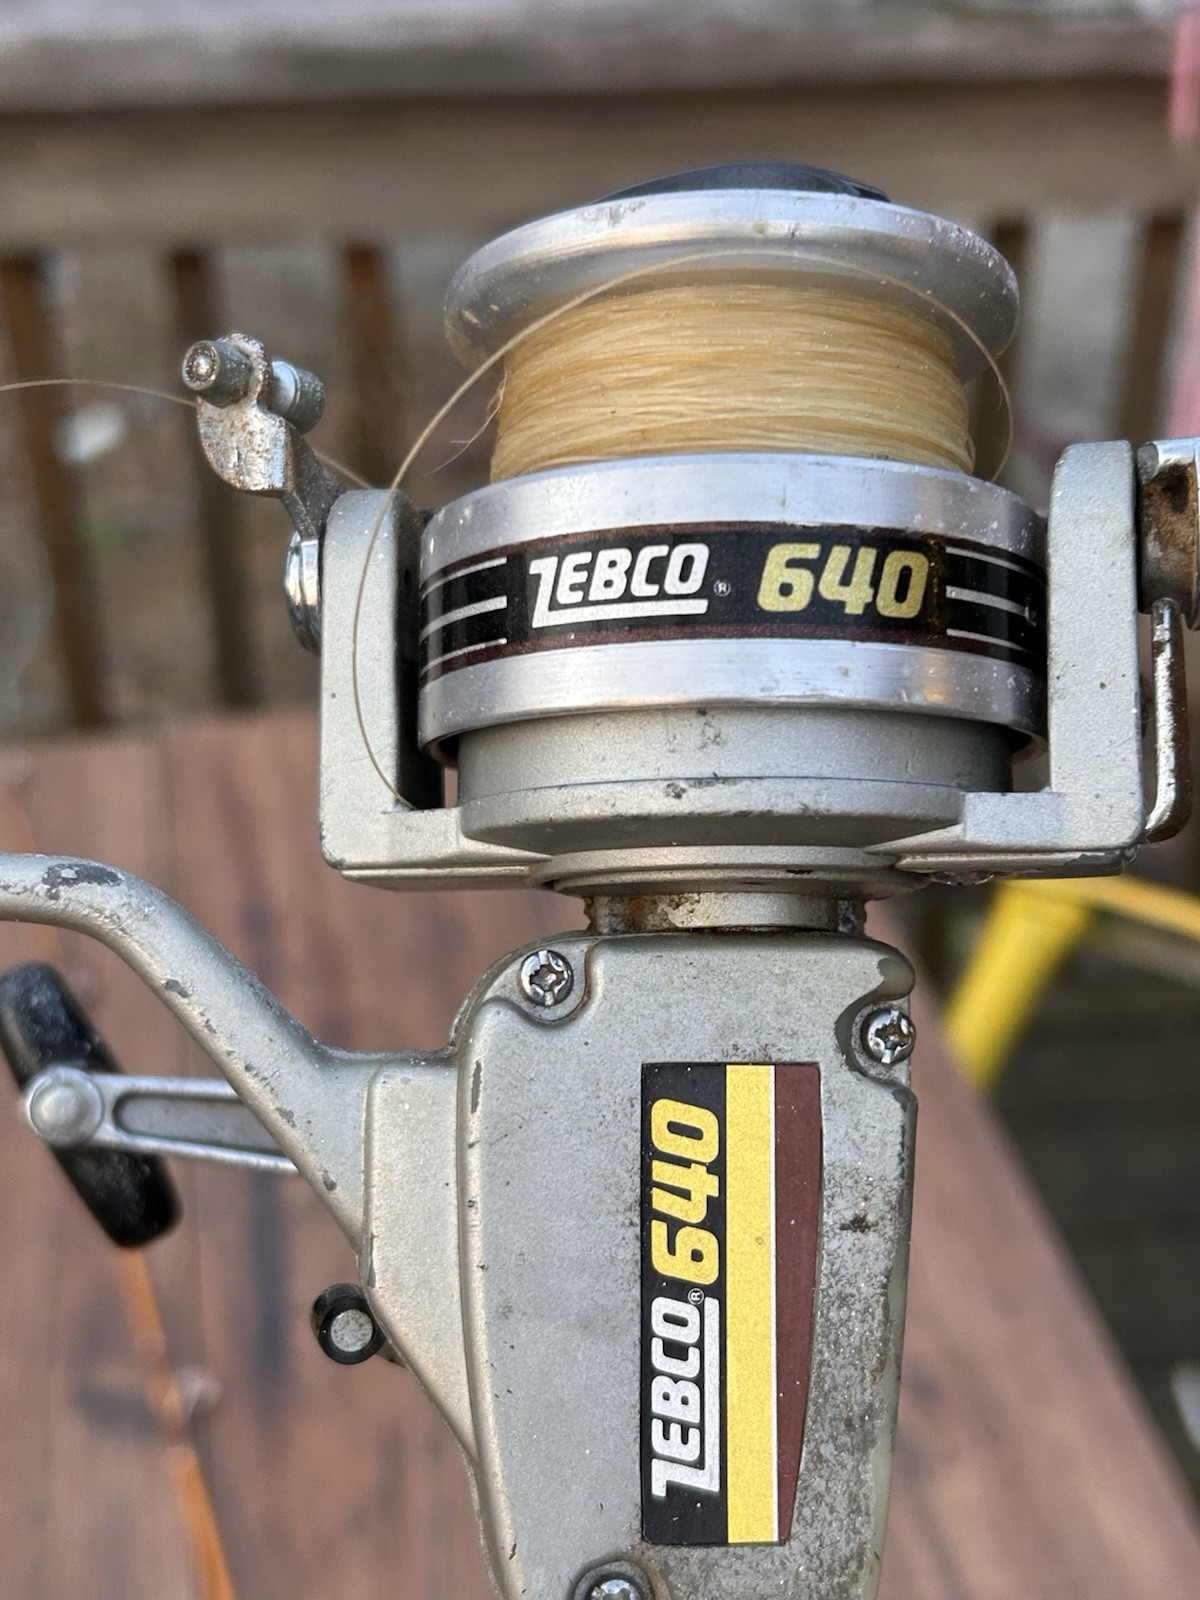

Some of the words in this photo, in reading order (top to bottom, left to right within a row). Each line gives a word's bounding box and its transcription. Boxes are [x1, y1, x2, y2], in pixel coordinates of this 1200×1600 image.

[528, 543, 709, 628] ZEBCO
[757, 543, 929, 619] 640
[651, 1098, 720, 1285] 640
[651, 1296, 720, 1497] ZEBCO
